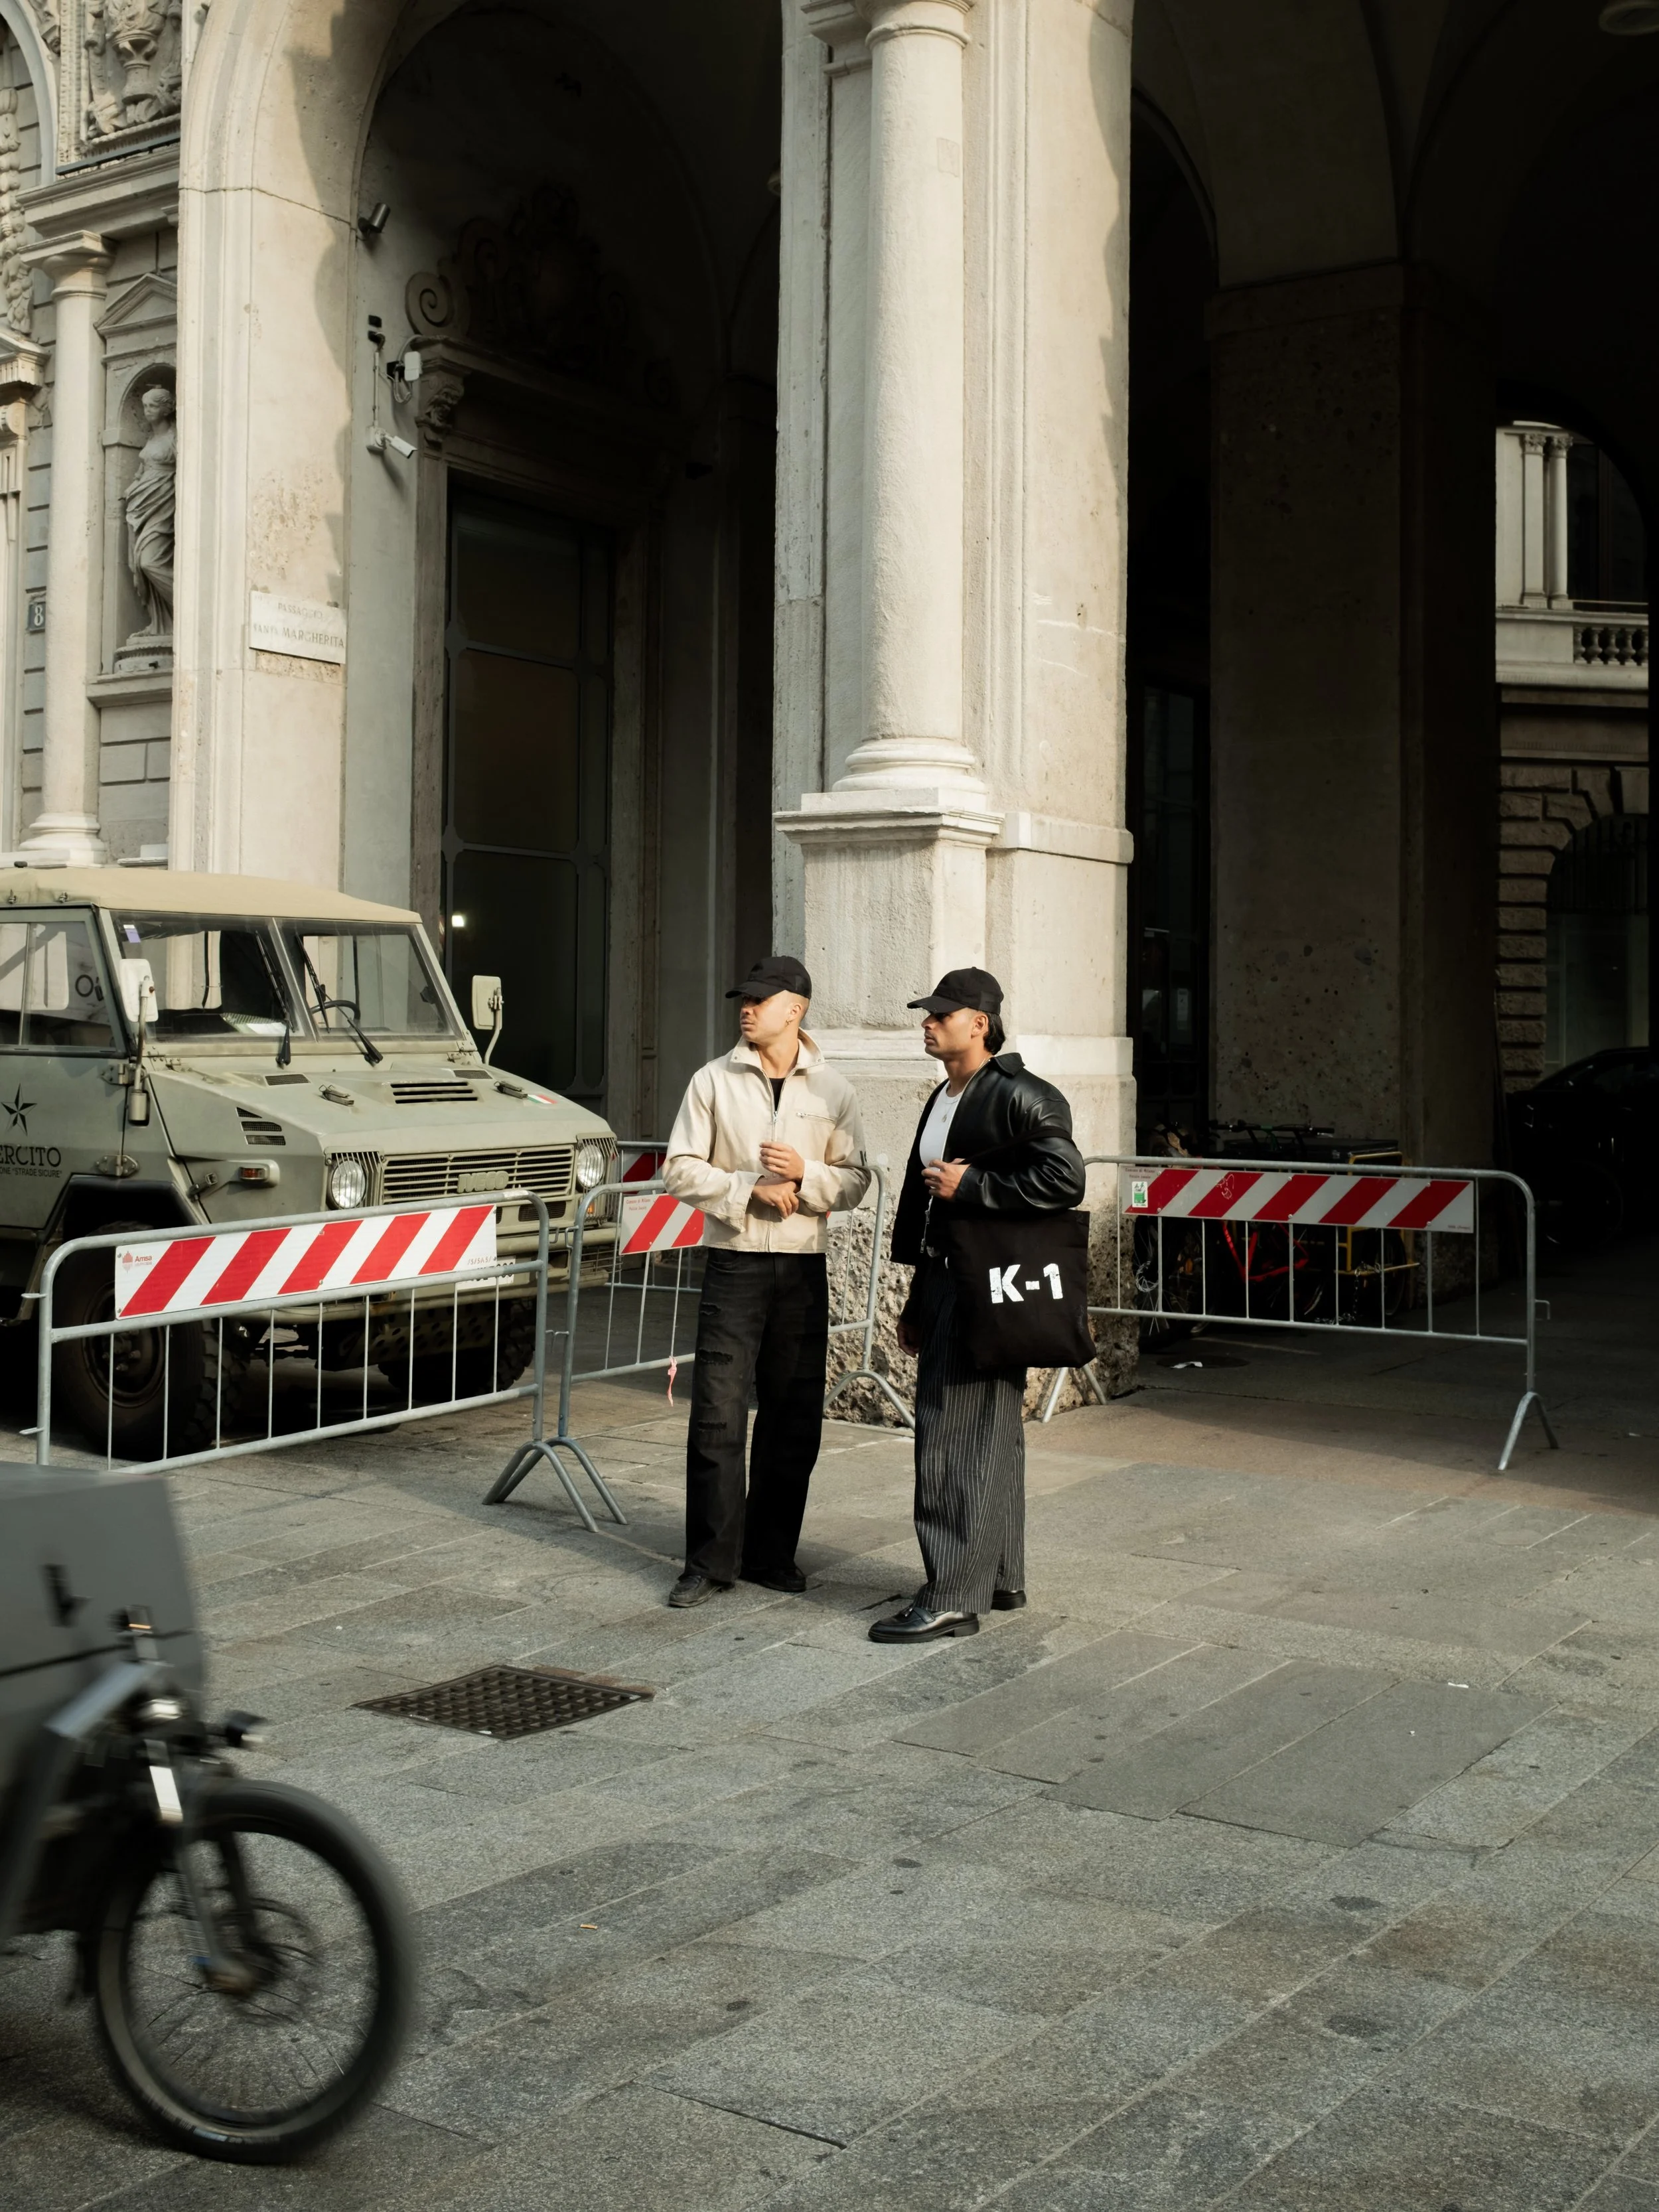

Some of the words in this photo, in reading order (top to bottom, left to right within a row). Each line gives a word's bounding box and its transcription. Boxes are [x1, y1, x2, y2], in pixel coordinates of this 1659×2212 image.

[34, 605, 44, 626] 8
[277, 603, 323, 620] PASSAGGIO
[282, 627, 344, 648] MARGHERITA
[457, 1170, 509, 1194] IVECO
[989, 1263, 1064, 1304] K-1
